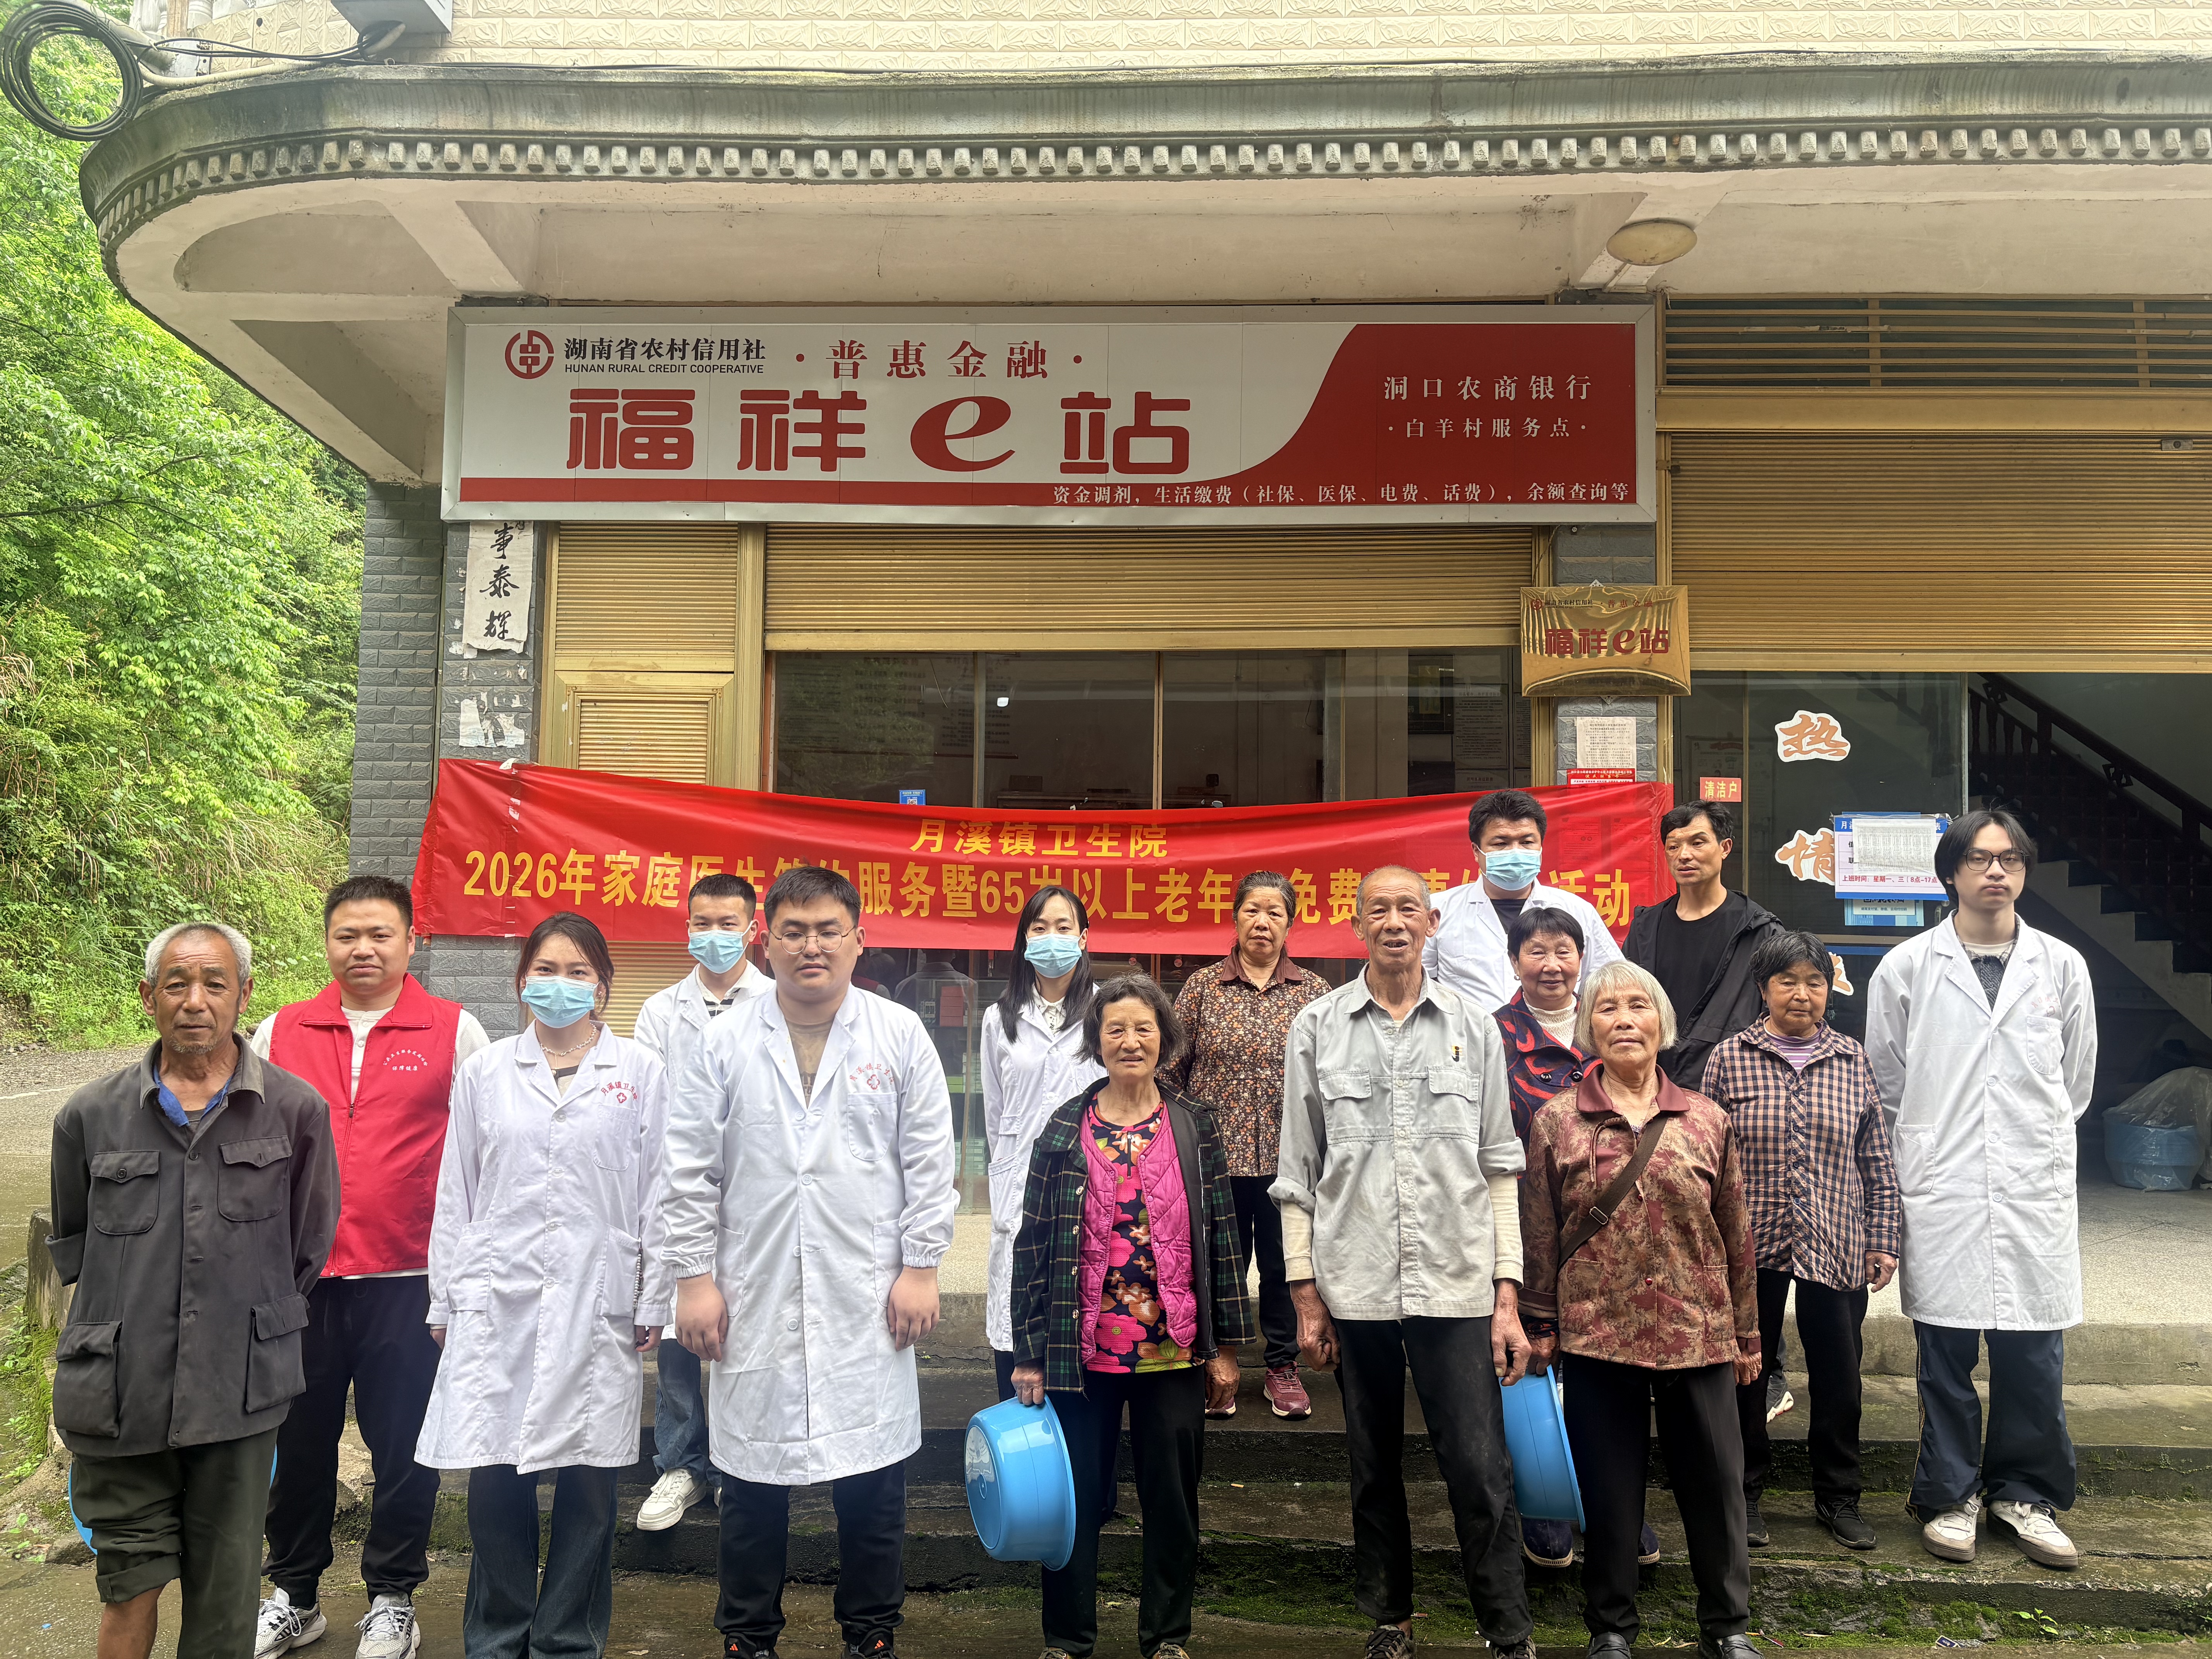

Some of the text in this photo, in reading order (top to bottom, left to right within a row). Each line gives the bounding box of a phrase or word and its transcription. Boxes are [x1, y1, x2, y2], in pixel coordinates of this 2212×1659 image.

[564, 337, 766, 361] 湖南省农村信用社
[565, 364, 764, 374] HUNAN RURAL CREDIT COOPERATIVE
[1384, 374, 1591, 401] 洞口农商银行
[567, 388, 1190, 474] 福祥e站
[1545, 628, 1669, 654] 福祥e站
[1704, 780, 1737, 798] 清洁户
[910, 818, 1168, 859] 月溪镇卫生院
[601, 1081, 638, 1101] 月溪镇卫生院
